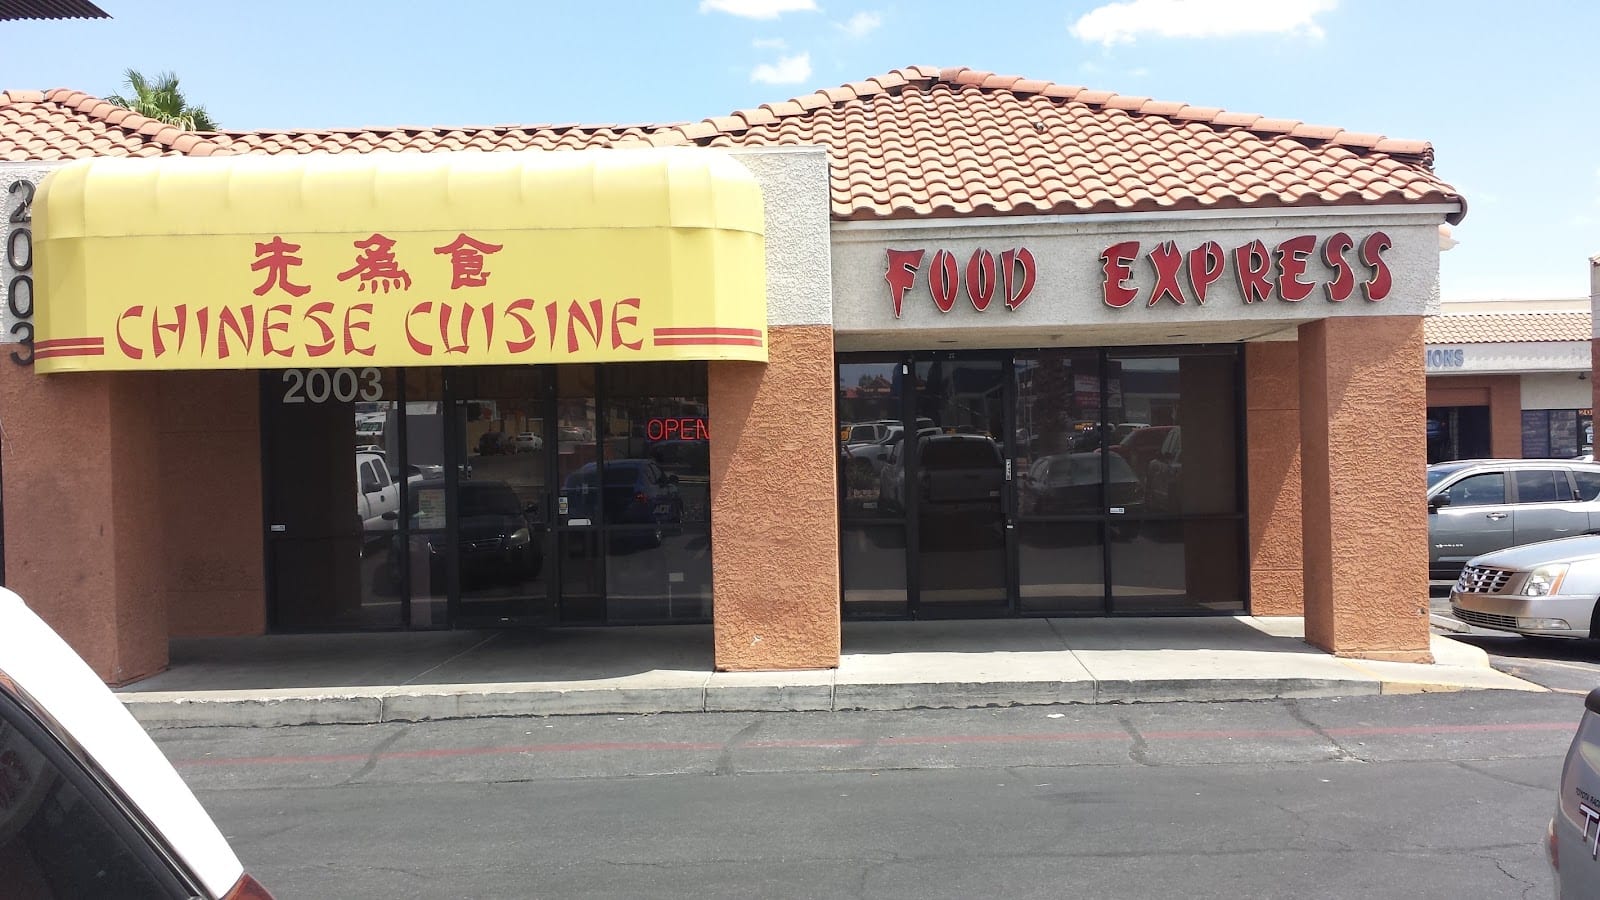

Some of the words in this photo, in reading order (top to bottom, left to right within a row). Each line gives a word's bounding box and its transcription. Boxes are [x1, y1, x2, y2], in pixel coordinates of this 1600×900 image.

[7, 179, 36, 366] 2003
[884, 247, 1038, 319] FOOD
[1101, 231, 1393, 308] EXPRESS
[116, 301, 377, 360] CHINESE
[405, 298, 643, 355] CUISINE
[282, 367, 384, 403] 2003
[647, 418, 710, 441] OPEN
